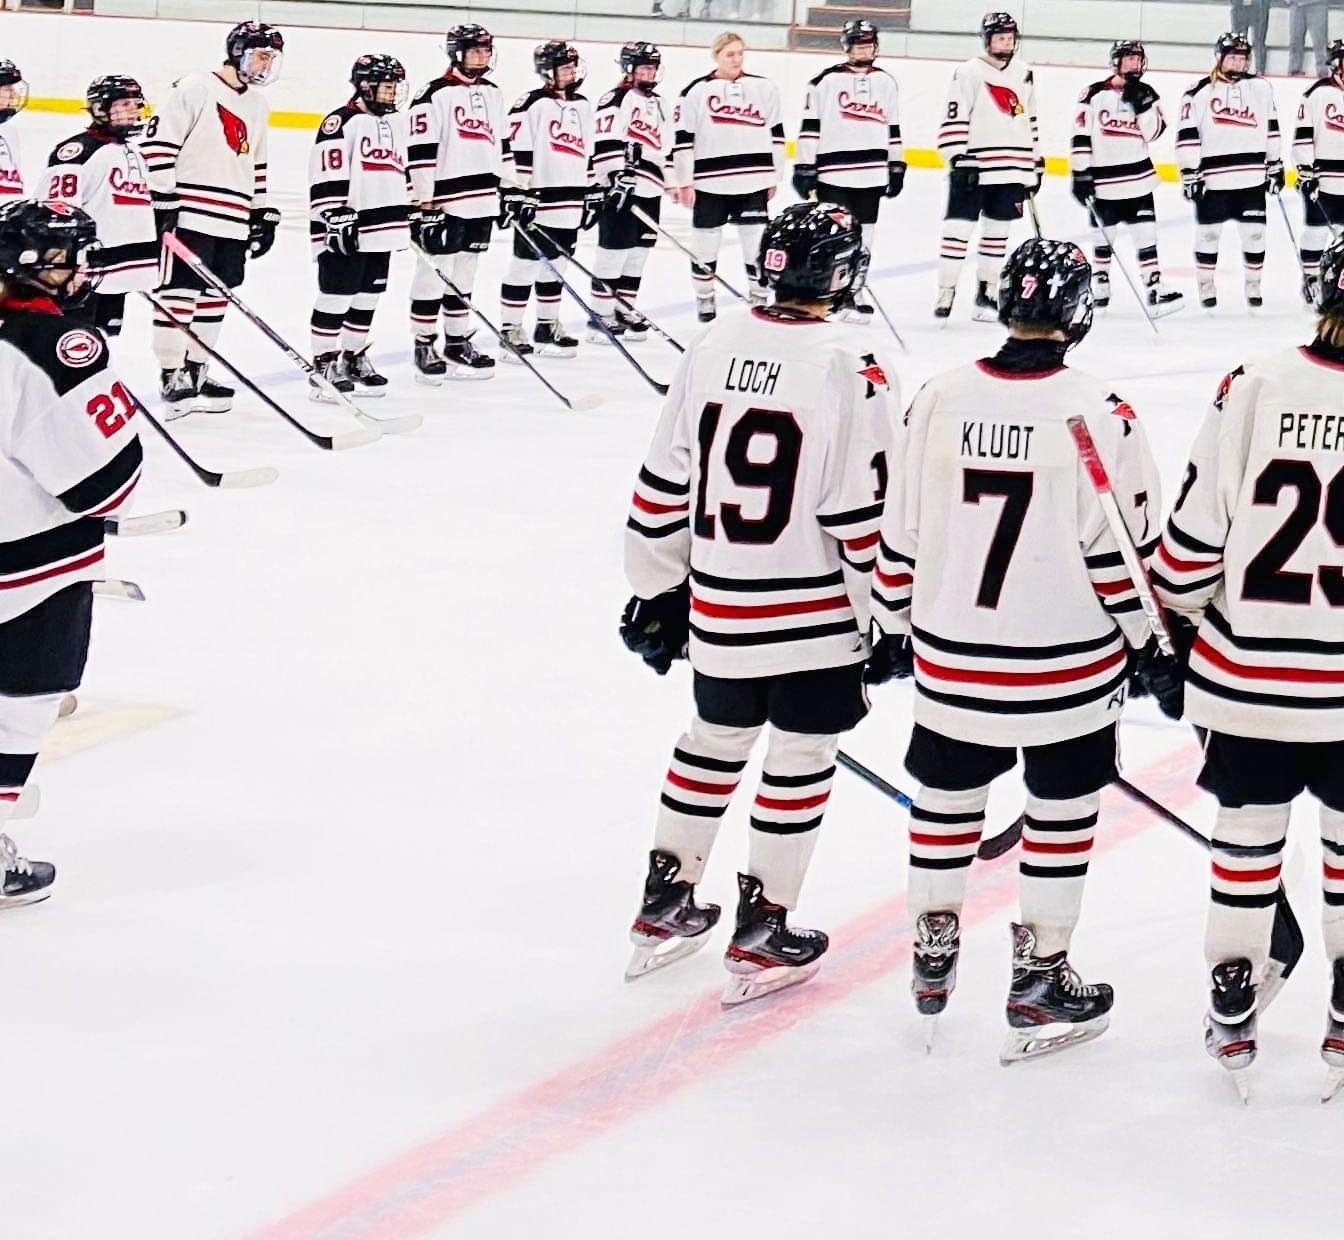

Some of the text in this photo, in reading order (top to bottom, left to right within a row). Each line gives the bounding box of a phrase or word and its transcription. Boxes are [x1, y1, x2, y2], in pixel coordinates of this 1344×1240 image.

[708, 95, 765, 120] Cards
[321, 147, 343, 172] 18
[49, 173, 79, 199] 28
[766, 249, 786, 269] 19
[1021, 276, 1037, 298] 7
[725, 357, 782, 396] LOCH
[85, 380, 140, 440] 21
[693, 402, 803, 545] 19
[961, 468, 1034, 610] 7
